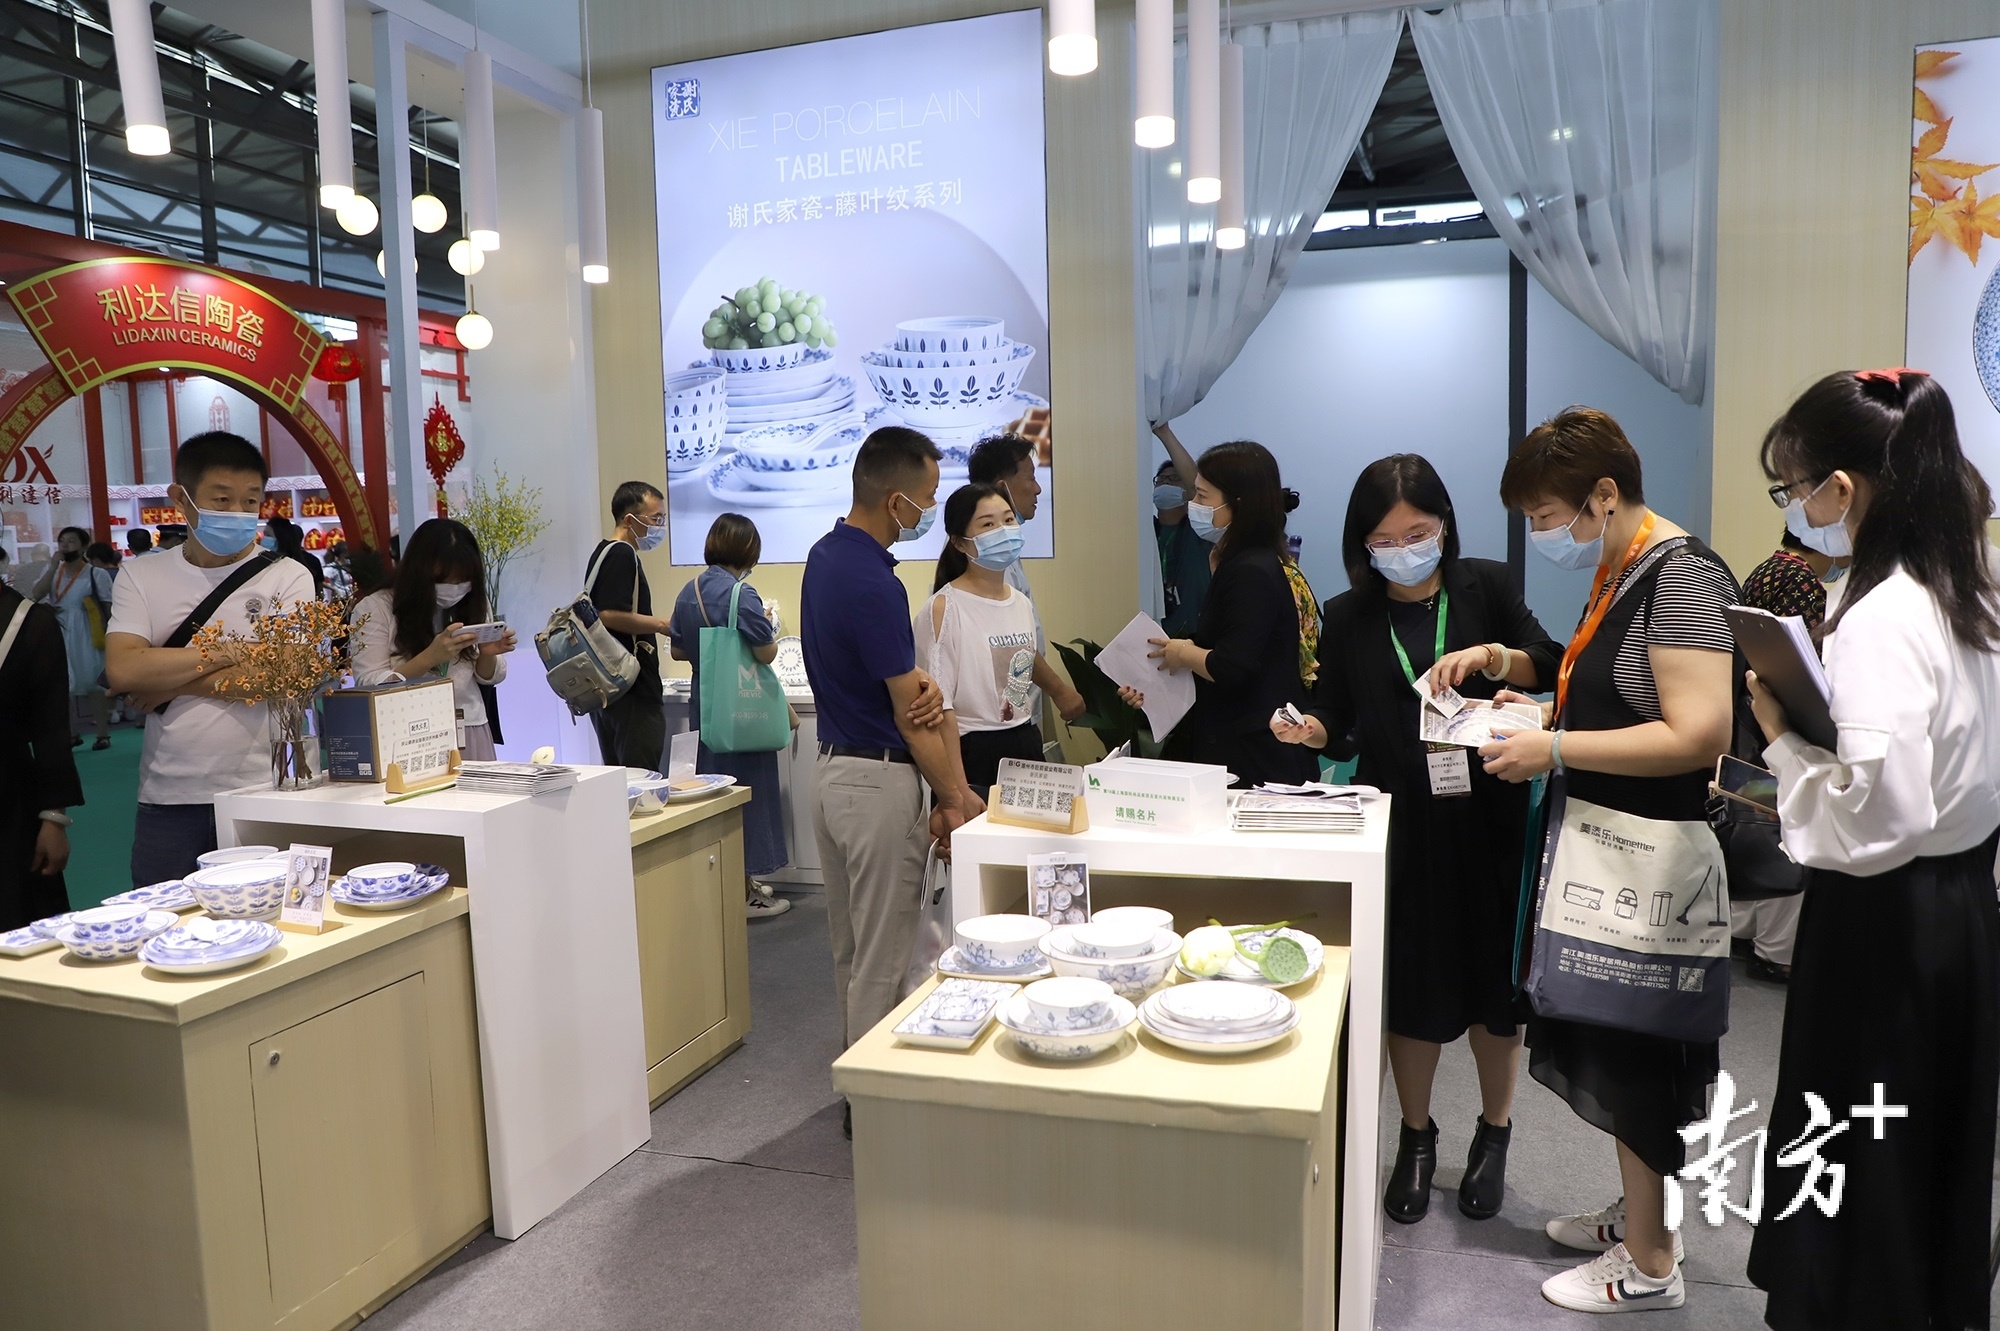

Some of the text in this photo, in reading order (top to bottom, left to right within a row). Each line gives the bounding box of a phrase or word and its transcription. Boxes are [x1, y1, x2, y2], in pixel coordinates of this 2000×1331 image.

[708, 86, 981, 153] XIE PORCELAIN
[775, 140, 924, 183] TABLEWARE
[727, 178, 963, 230] 谢氏家瓷-藤叶纹系列
[97, 284, 265, 348] 利达信陶瓷
[112, 328, 257, 362] LIDAXIN CERAMICS
[1115, 806, 1156, 821] 请赐名片
